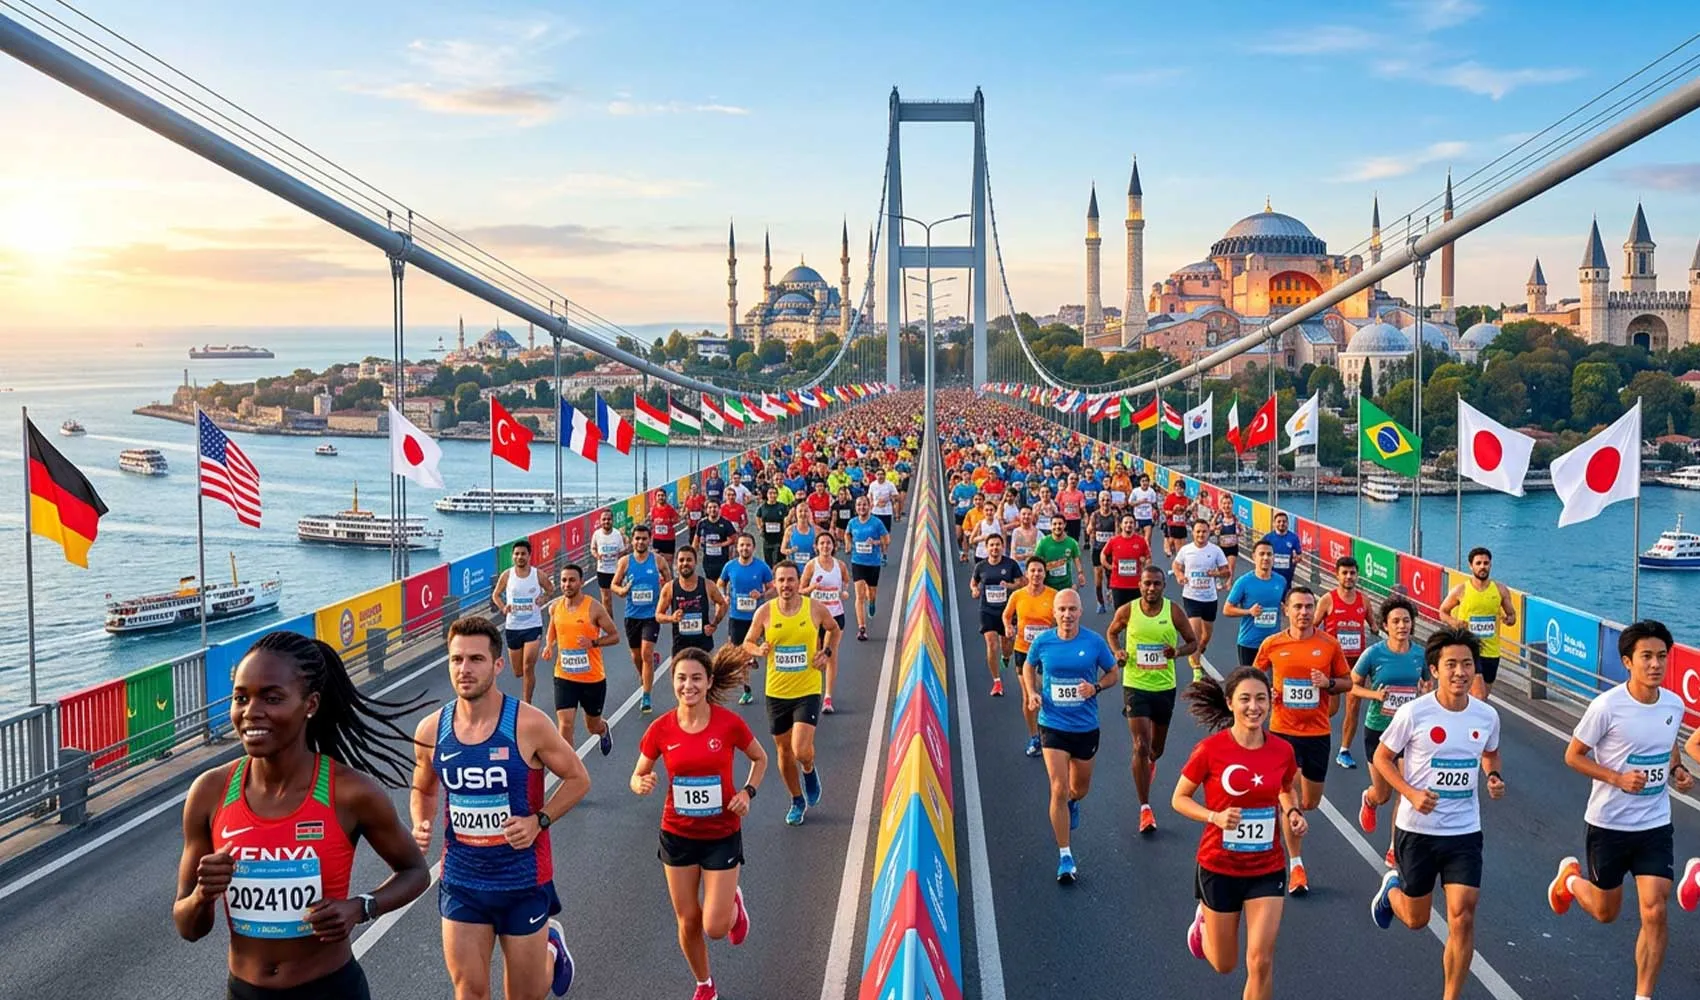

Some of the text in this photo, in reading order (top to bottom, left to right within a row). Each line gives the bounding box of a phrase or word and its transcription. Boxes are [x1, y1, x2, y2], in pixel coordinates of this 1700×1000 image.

[442, 766, 508, 790] USA
[685, 789, 710, 805] 185
[1236, 824, 1264, 839] 512
[229, 885, 316, 912] 2024102
